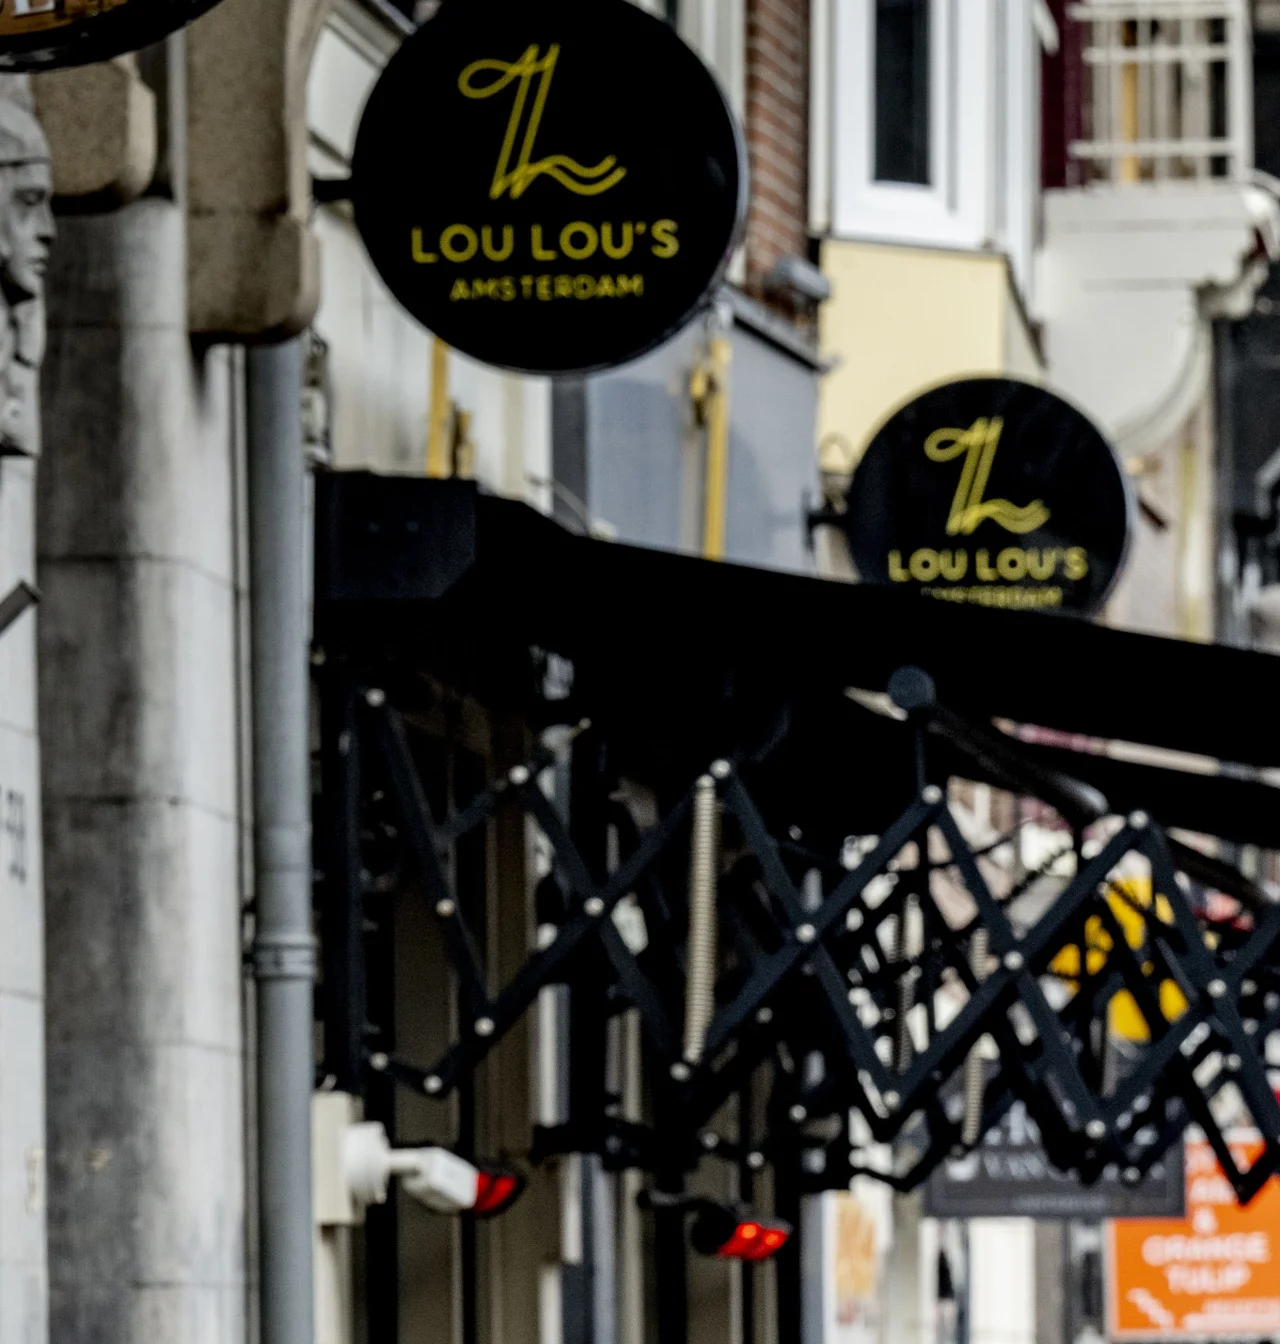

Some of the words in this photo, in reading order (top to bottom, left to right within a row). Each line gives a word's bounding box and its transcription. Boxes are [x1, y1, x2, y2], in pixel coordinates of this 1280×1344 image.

[412, 223, 514, 263] LOU
[531, 219, 680, 261] LOU'S
[450, 274, 645, 301] AMSTERDAM
[888, 548, 968, 581] LOU
[976, 546, 1088, 580] LOU'S
[1142, 1233, 1269, 1266] ORANGE
[1165, 1264, 1251, 1294] TULIP
